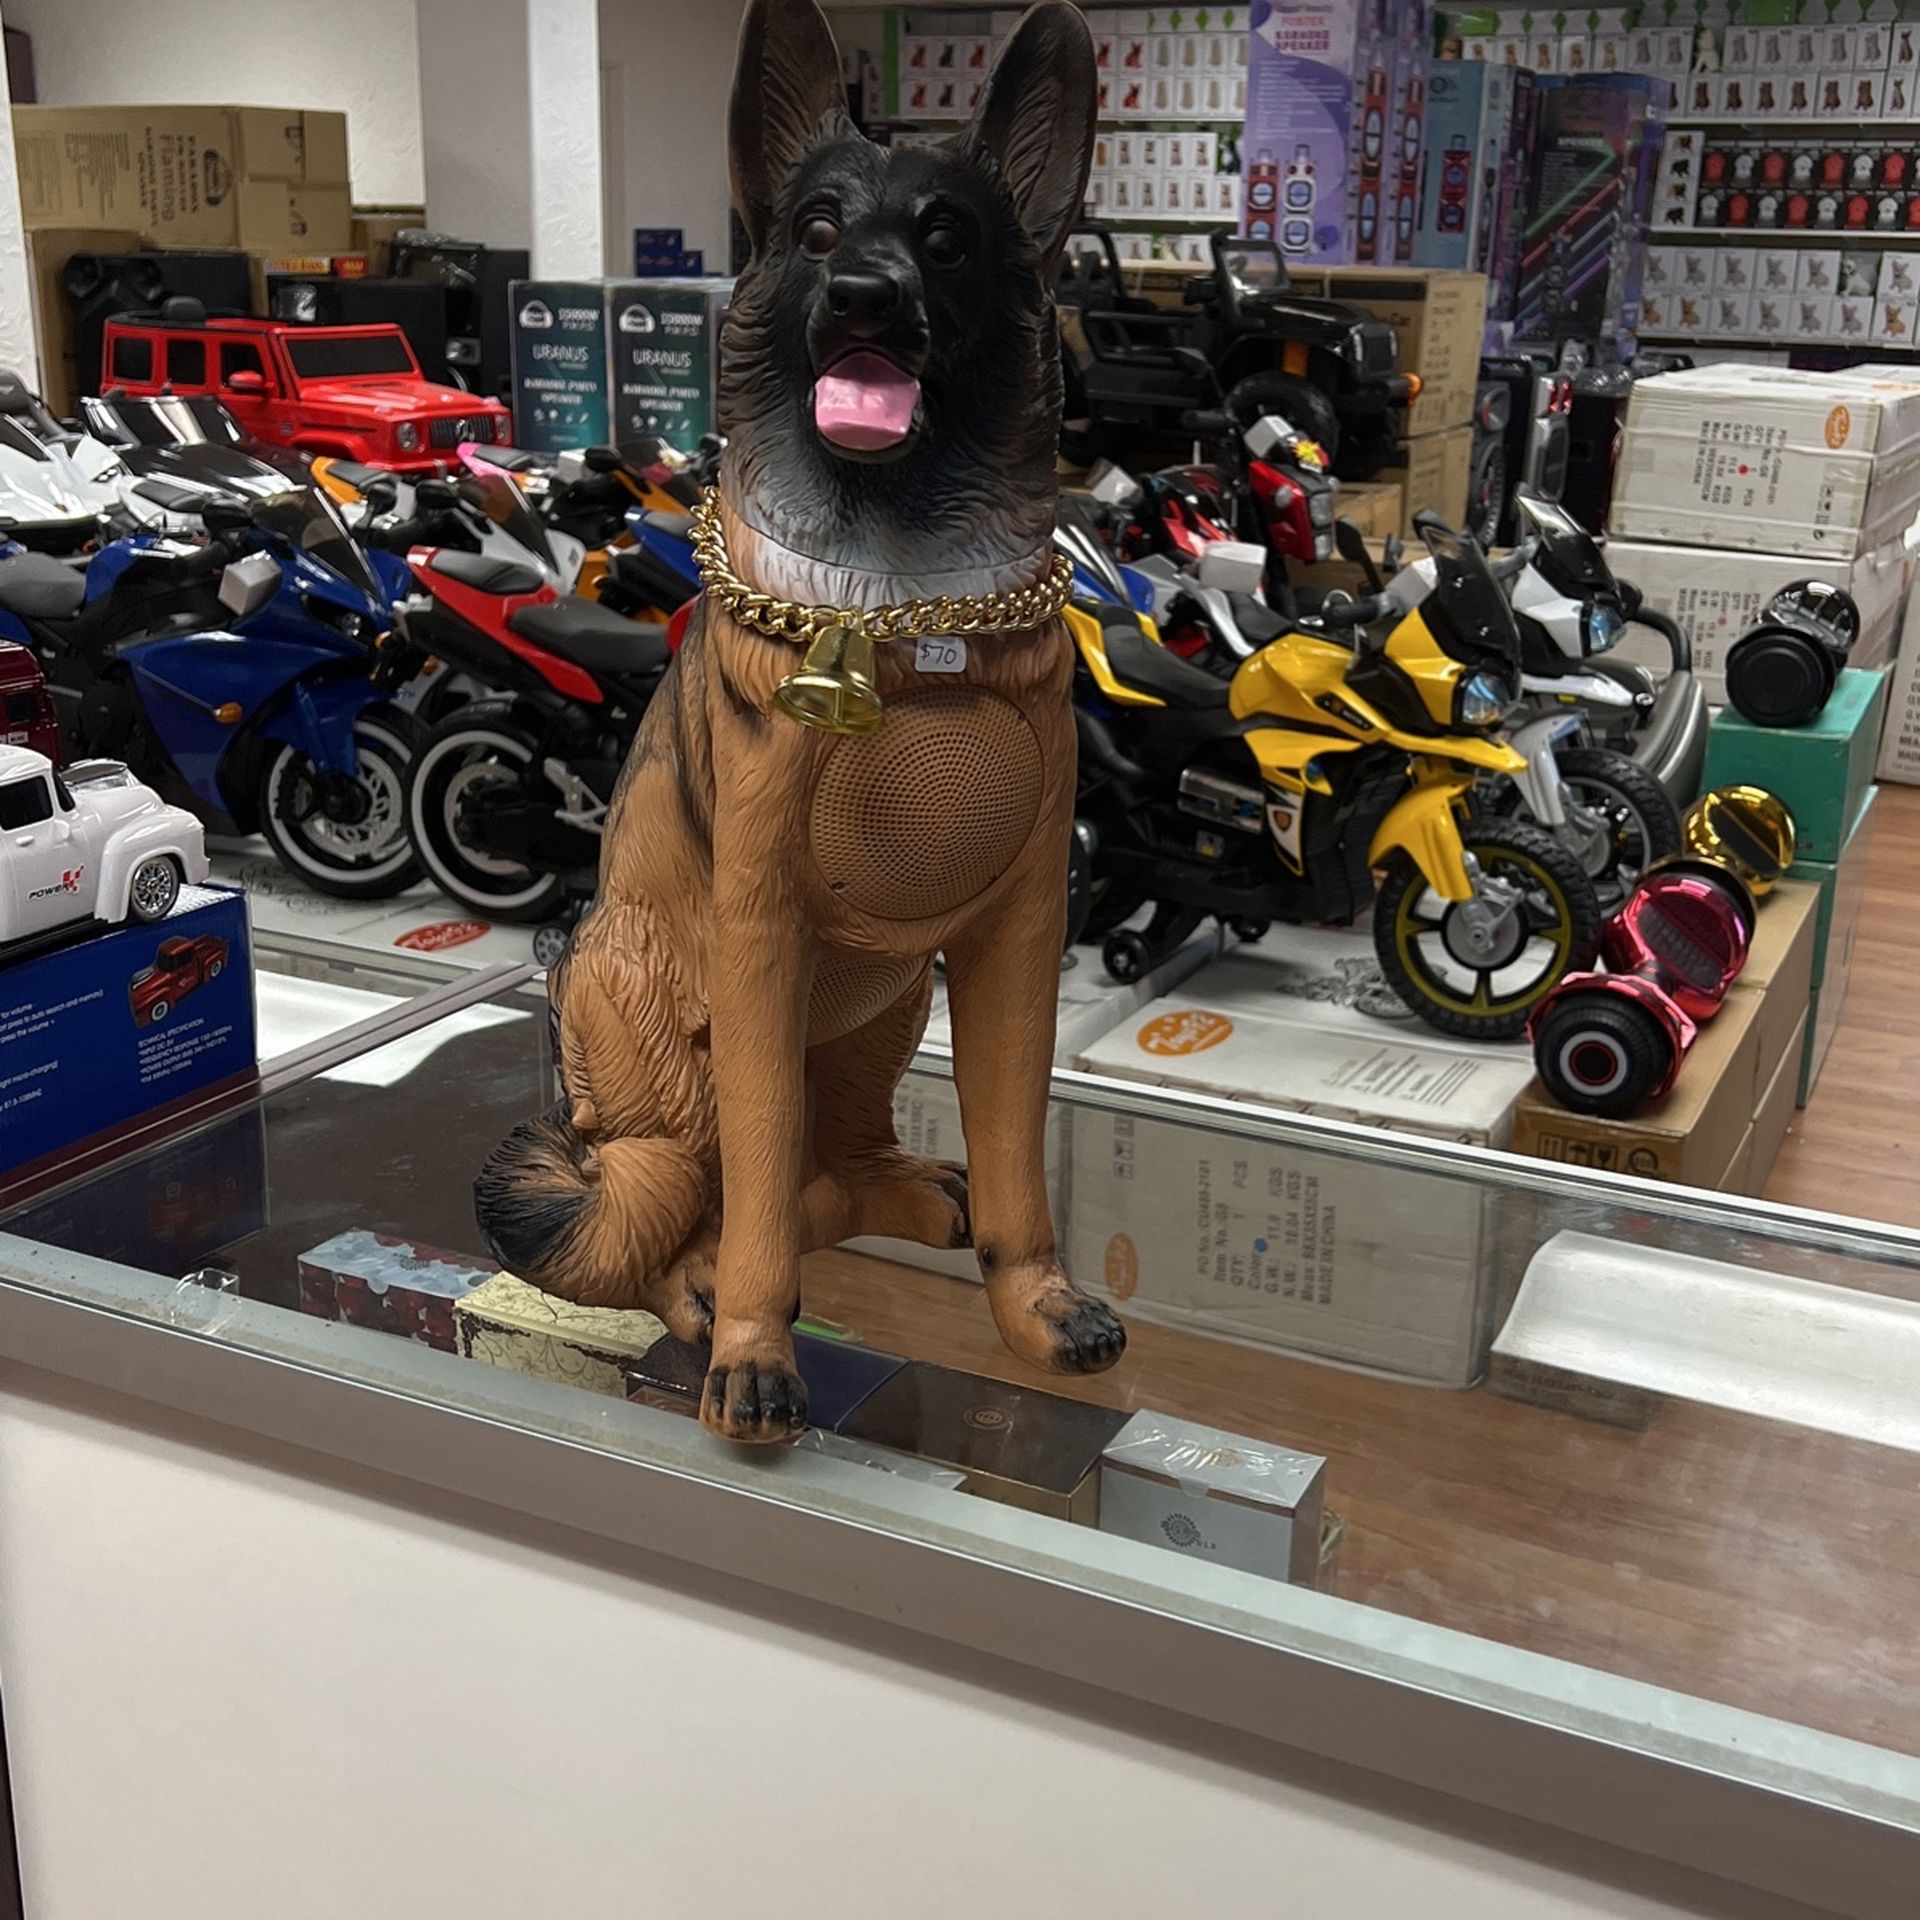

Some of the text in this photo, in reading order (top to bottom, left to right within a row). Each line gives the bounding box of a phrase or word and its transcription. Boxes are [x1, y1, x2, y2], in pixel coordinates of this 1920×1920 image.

[160, 134, 176, 222] Flaming
[532, 344, 589, 361] URANUS
[633, 349, 692, 367] URANUS
[920, 643, 957, 665] $70
[29, 883, 69, 900] POWER
[1233, 1160, 1247, 1189] PCS
[1268, 1167, 1283, 1197] KGS
[1286, 1170, 1301, 1201] KGS
[1214, 1254, 1227, 1282] Item
[1319, 1205, 1335, 1305] MADE IN CHINA
